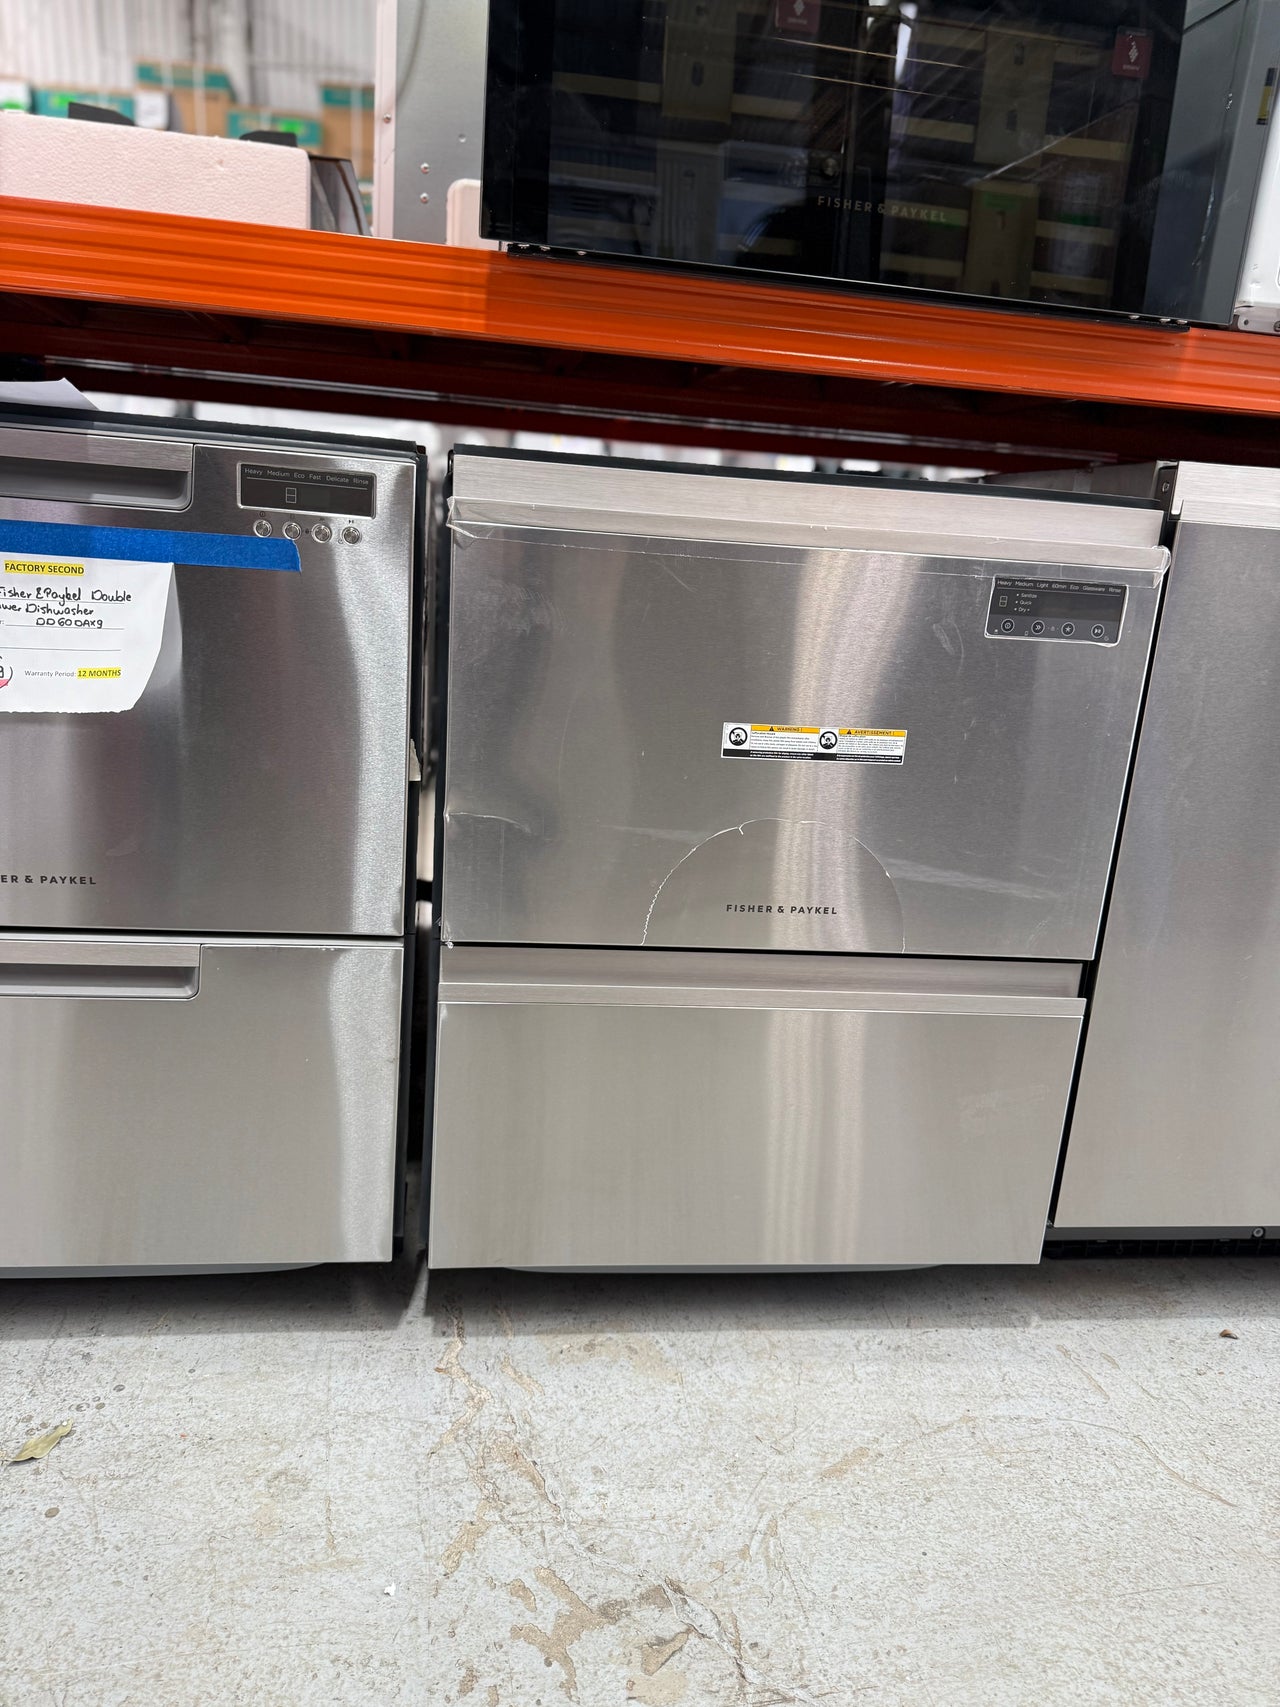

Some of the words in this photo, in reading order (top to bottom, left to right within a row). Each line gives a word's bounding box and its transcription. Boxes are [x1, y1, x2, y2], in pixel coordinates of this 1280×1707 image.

[817, 195, 873, 213] FISHER
[877, 203, 886, 214] &
[891, 205, 947, 222] PAYKEL
[244, 468, 263, 476] Heavy
[267, 469, 290, 477] Medium
[308, 473, 322, 481] Fast
[326, 475, 349, 483] Delicate
[353, 477, 369, 485] Rinse
[4, 562, 46, 573] FACTORY
[47, 565, 85, 575] SECOND
[91, 589, 133, 602] Double
[25, 603, 94, 616] Dishwasher
[24, 669, 54, 677] Warranty
[77, 670, 87, 678] 12
[88, 669, 122, 677] MONTHS
[24, 875, 34, 884] &
[40, 875, 97, 885] PAYKEL
[726, 904, 773, 914] FISHER
[777, 905, 785, 914] &
[790, 906, 838, 915] PAYKEL
